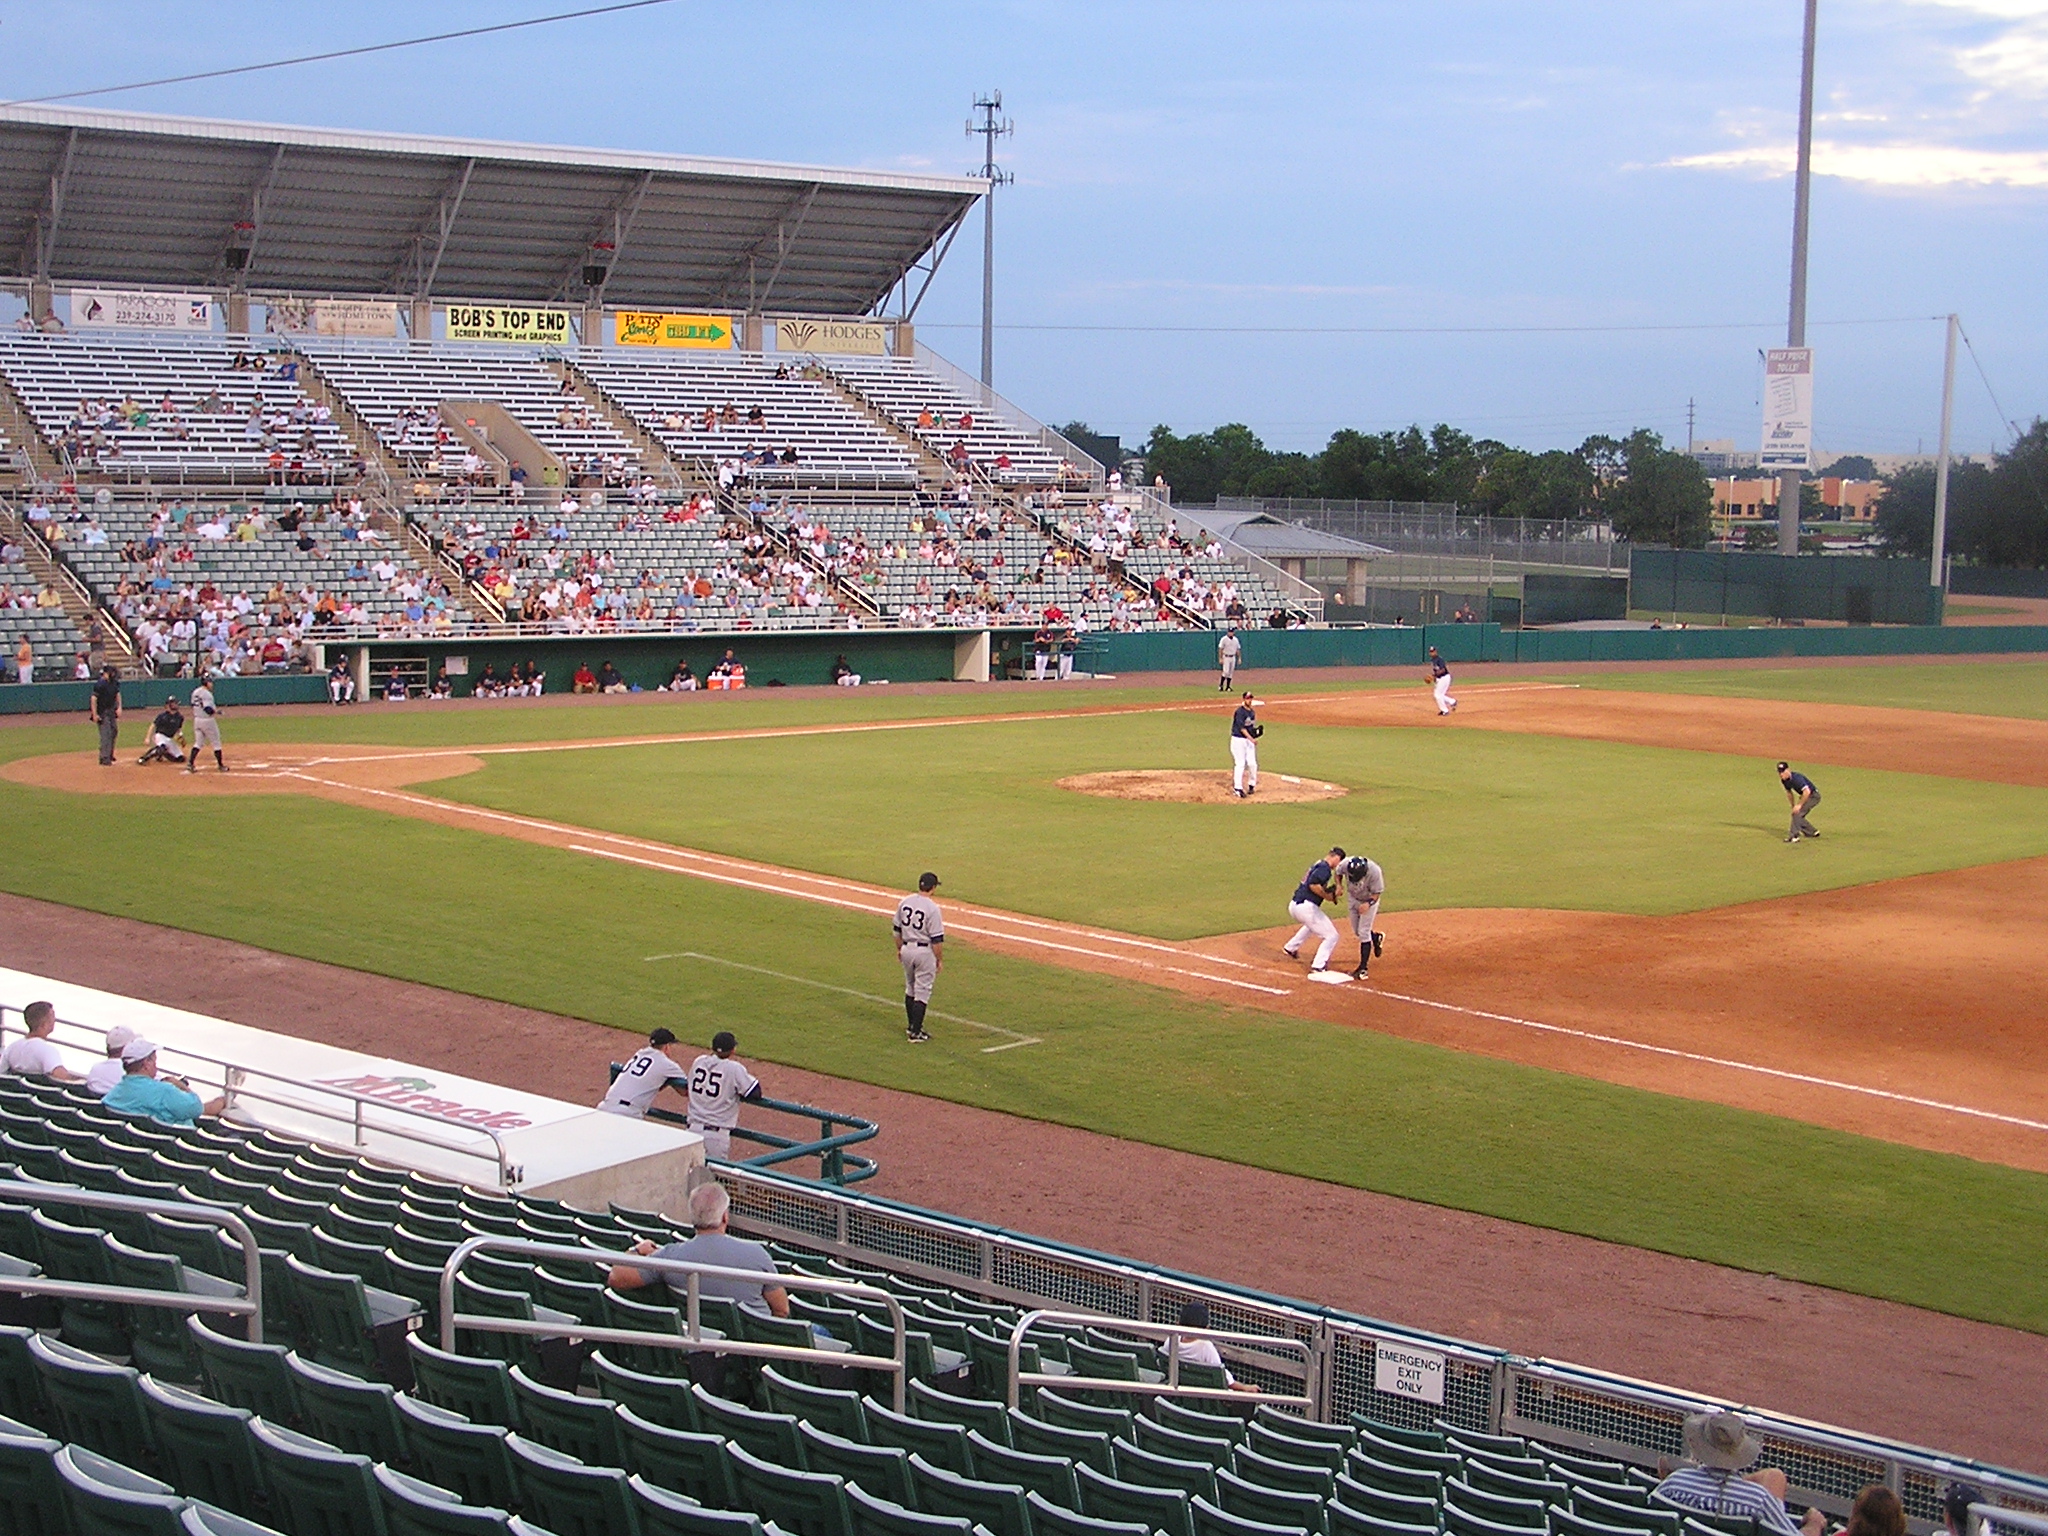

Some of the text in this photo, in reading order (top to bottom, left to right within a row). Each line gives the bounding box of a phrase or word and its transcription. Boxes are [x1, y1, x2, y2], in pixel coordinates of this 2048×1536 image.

[450, 308, 566, 331] BOB'S TOP END
[454, 329, 562, 342] SCREEN PRINTING and GRAPHICS
[823, 325, 881, 340] HODGES
[901, 906, 925, 930] 33
[692, 1067, 722, 1098] 25
[312, 1074, 532, 1130] Miracle
[1378, 1348, 1442, 1372] EMERGENCY
[1398, 1366, 1422, 1380] EXIT
[1396, 1379, 1423, 1394] ONLY
